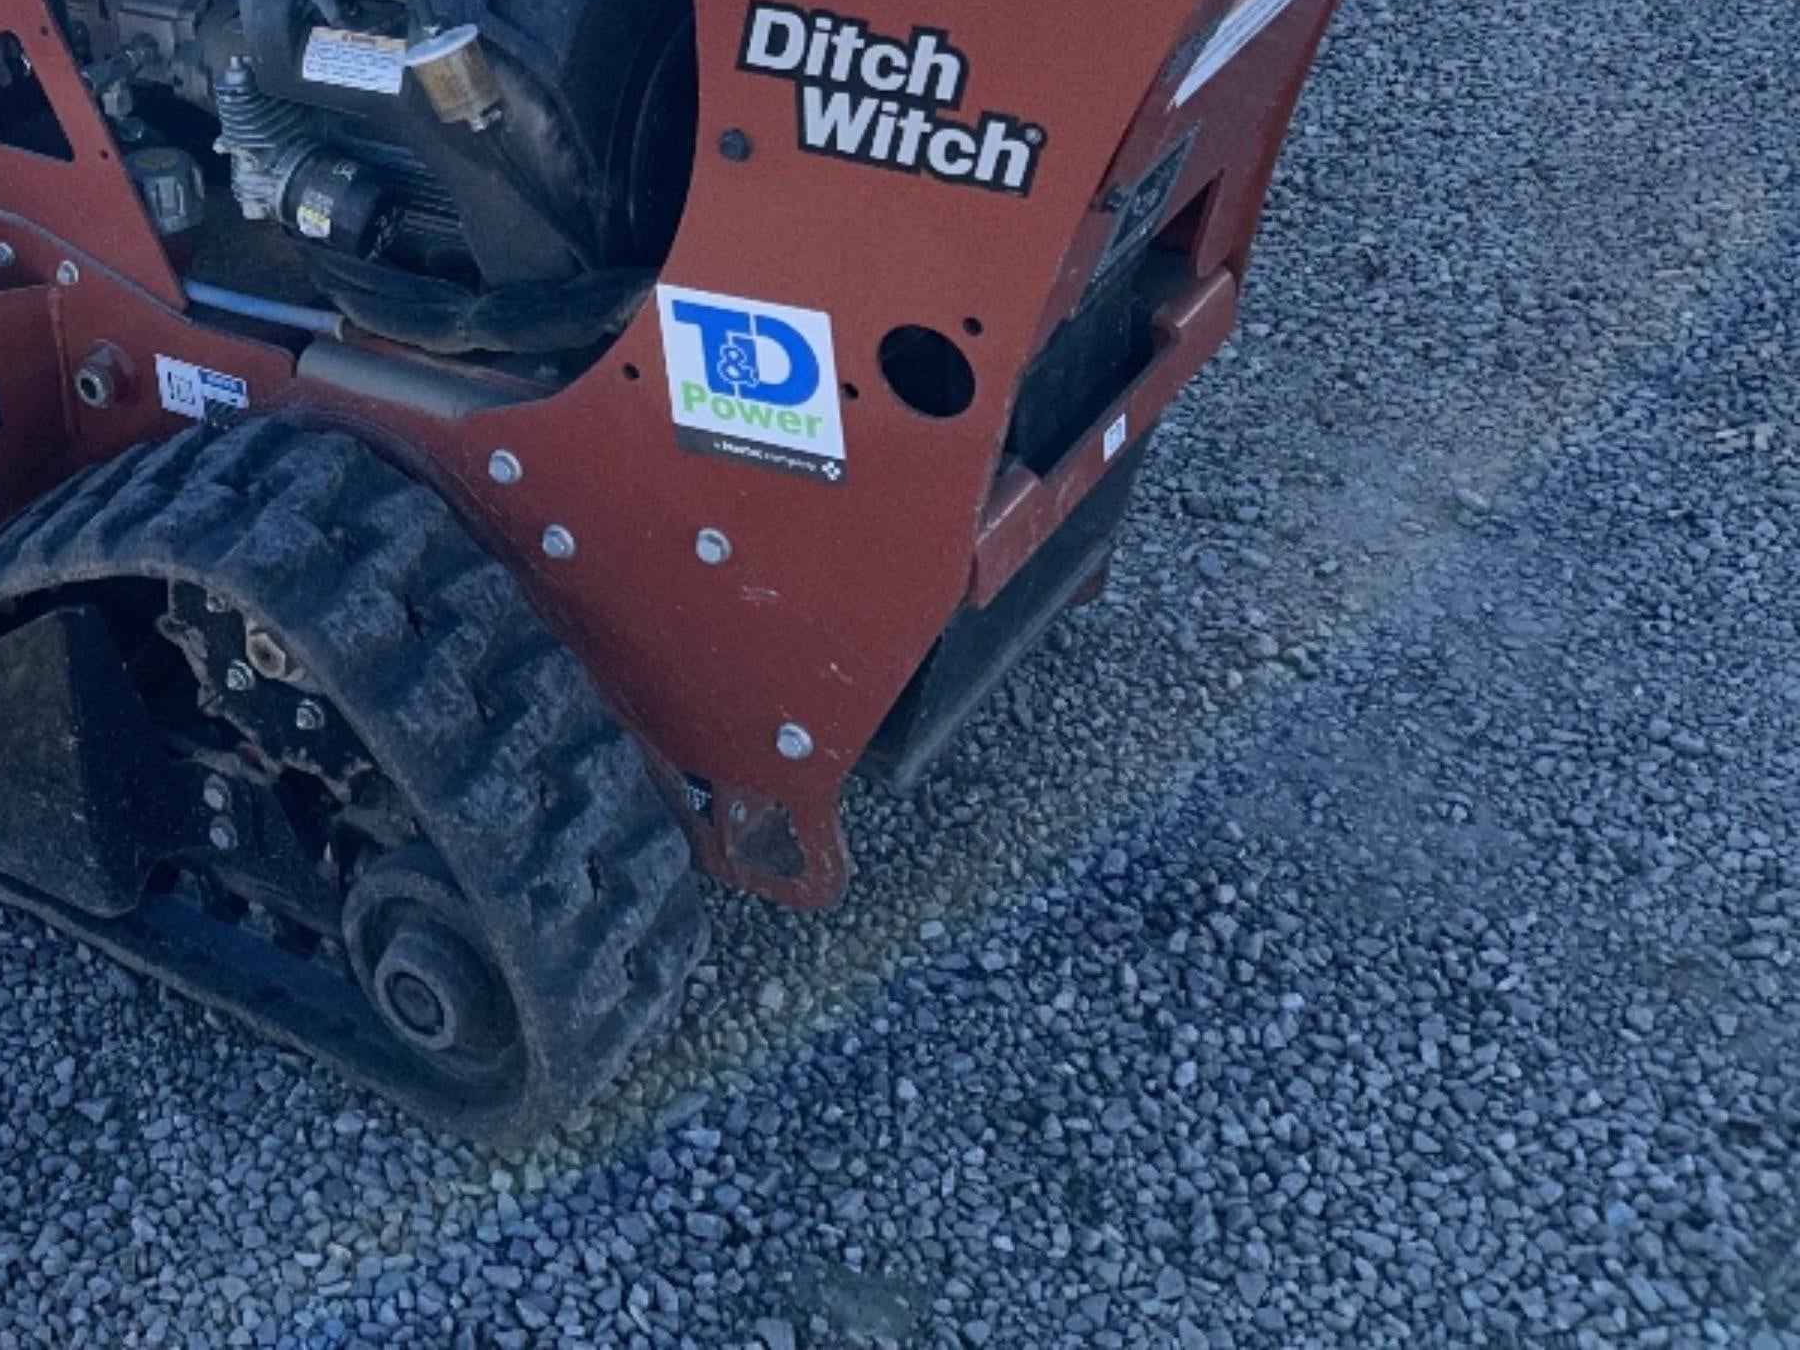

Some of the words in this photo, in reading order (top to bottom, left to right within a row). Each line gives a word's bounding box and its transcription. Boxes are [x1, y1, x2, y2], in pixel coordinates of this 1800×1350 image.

[746, 7, 961, 101] Ditch
[802, 86, 1031, 188] Witch
[671, 300, 820, 408] T&D
[680, 380, 823, 438] Power
